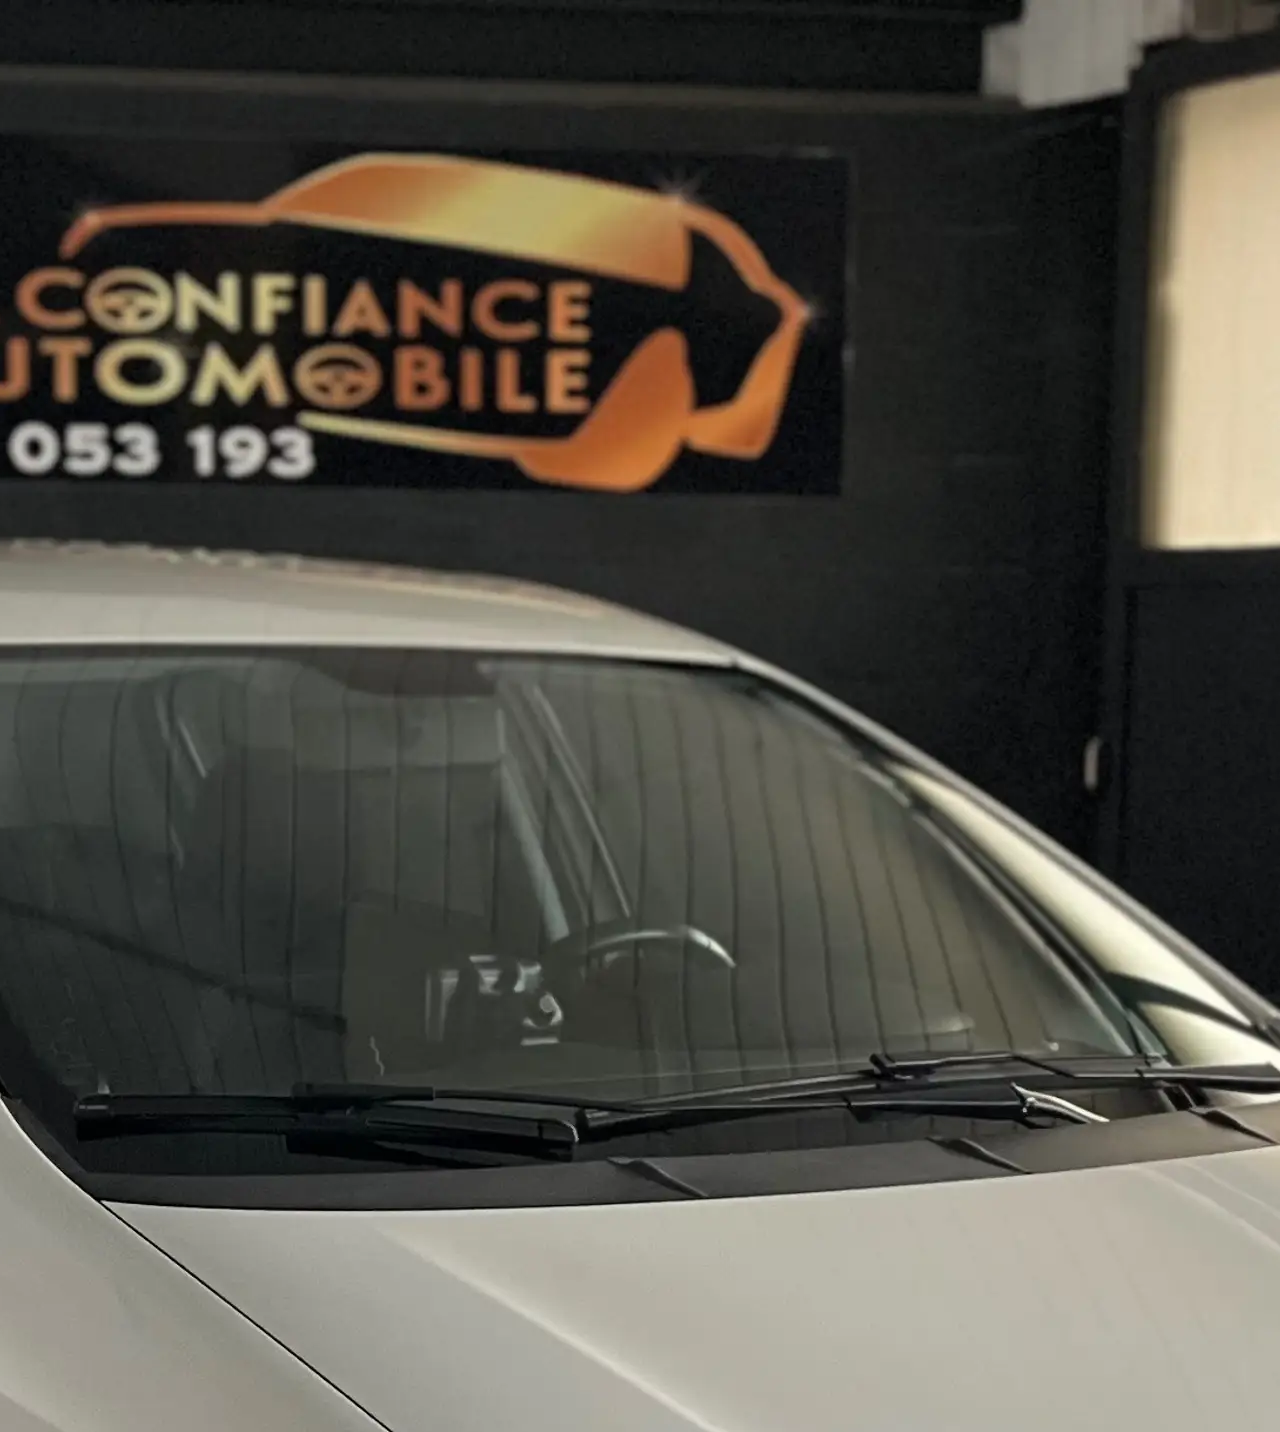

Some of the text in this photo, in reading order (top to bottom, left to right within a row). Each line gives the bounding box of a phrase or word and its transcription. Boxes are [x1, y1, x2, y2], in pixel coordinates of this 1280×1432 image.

[13, 264, 593, 343] CONFIANCE
[7, 419, 162, 478] 053
[184, 423, 317, 481] 193
